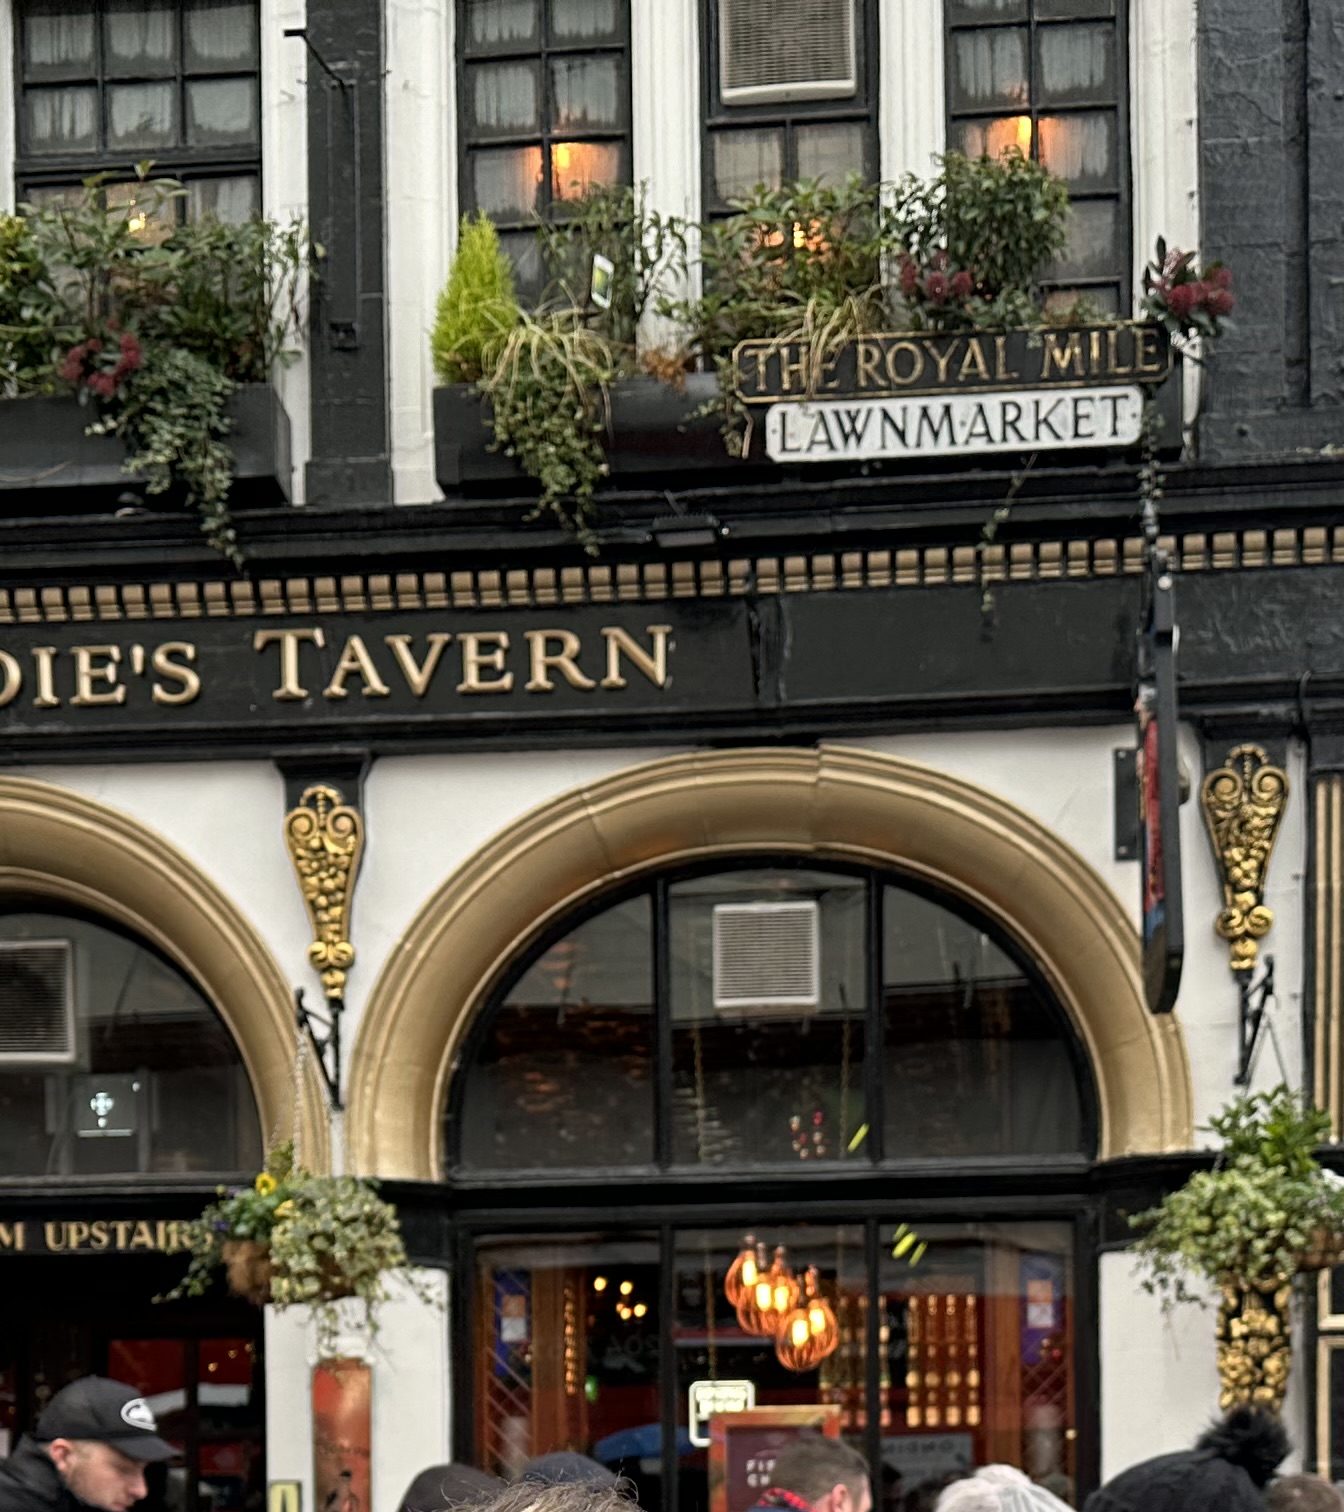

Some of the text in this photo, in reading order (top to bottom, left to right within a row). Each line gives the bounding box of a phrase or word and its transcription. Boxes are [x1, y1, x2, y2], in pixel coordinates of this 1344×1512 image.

[857, 332, 1020, 388] ROYAL
[1040, 328, 1162, 379] MILE
[778, 393, 1130, 454] LAWNMARKET
[254, 624, 673, 699] TAVERN
